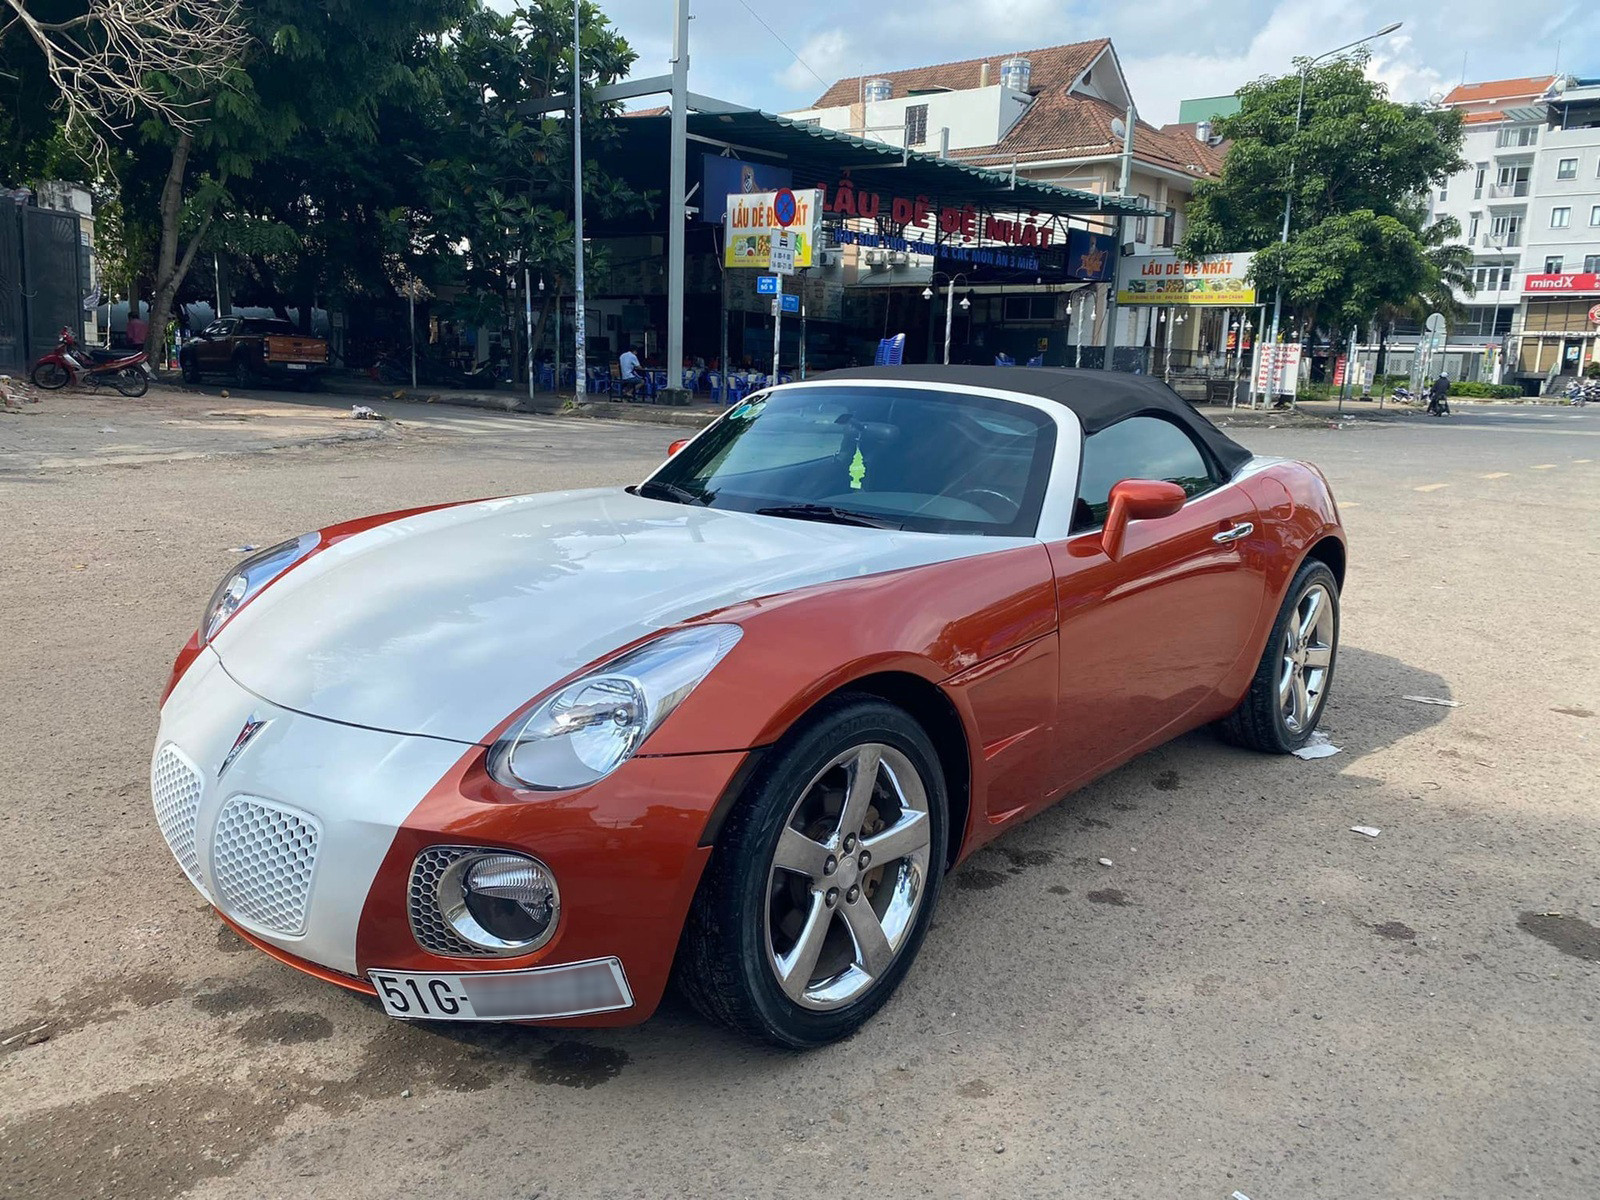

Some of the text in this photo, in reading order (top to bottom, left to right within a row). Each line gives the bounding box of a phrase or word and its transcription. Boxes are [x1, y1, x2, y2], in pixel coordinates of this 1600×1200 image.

[752, 201, 764, 228] DÊ
[892, 194, 930, 229] DÊ
[939, 204, 977, 243] ĐỆ
[985, 210, 1054, 249] NHẤT
[940, 246, 949, 258] &
[1010, 255, 1016, 267] 3
[1165, 260, 1181, 275] DÊ
[1530, 275, 1575, 288] mindX
